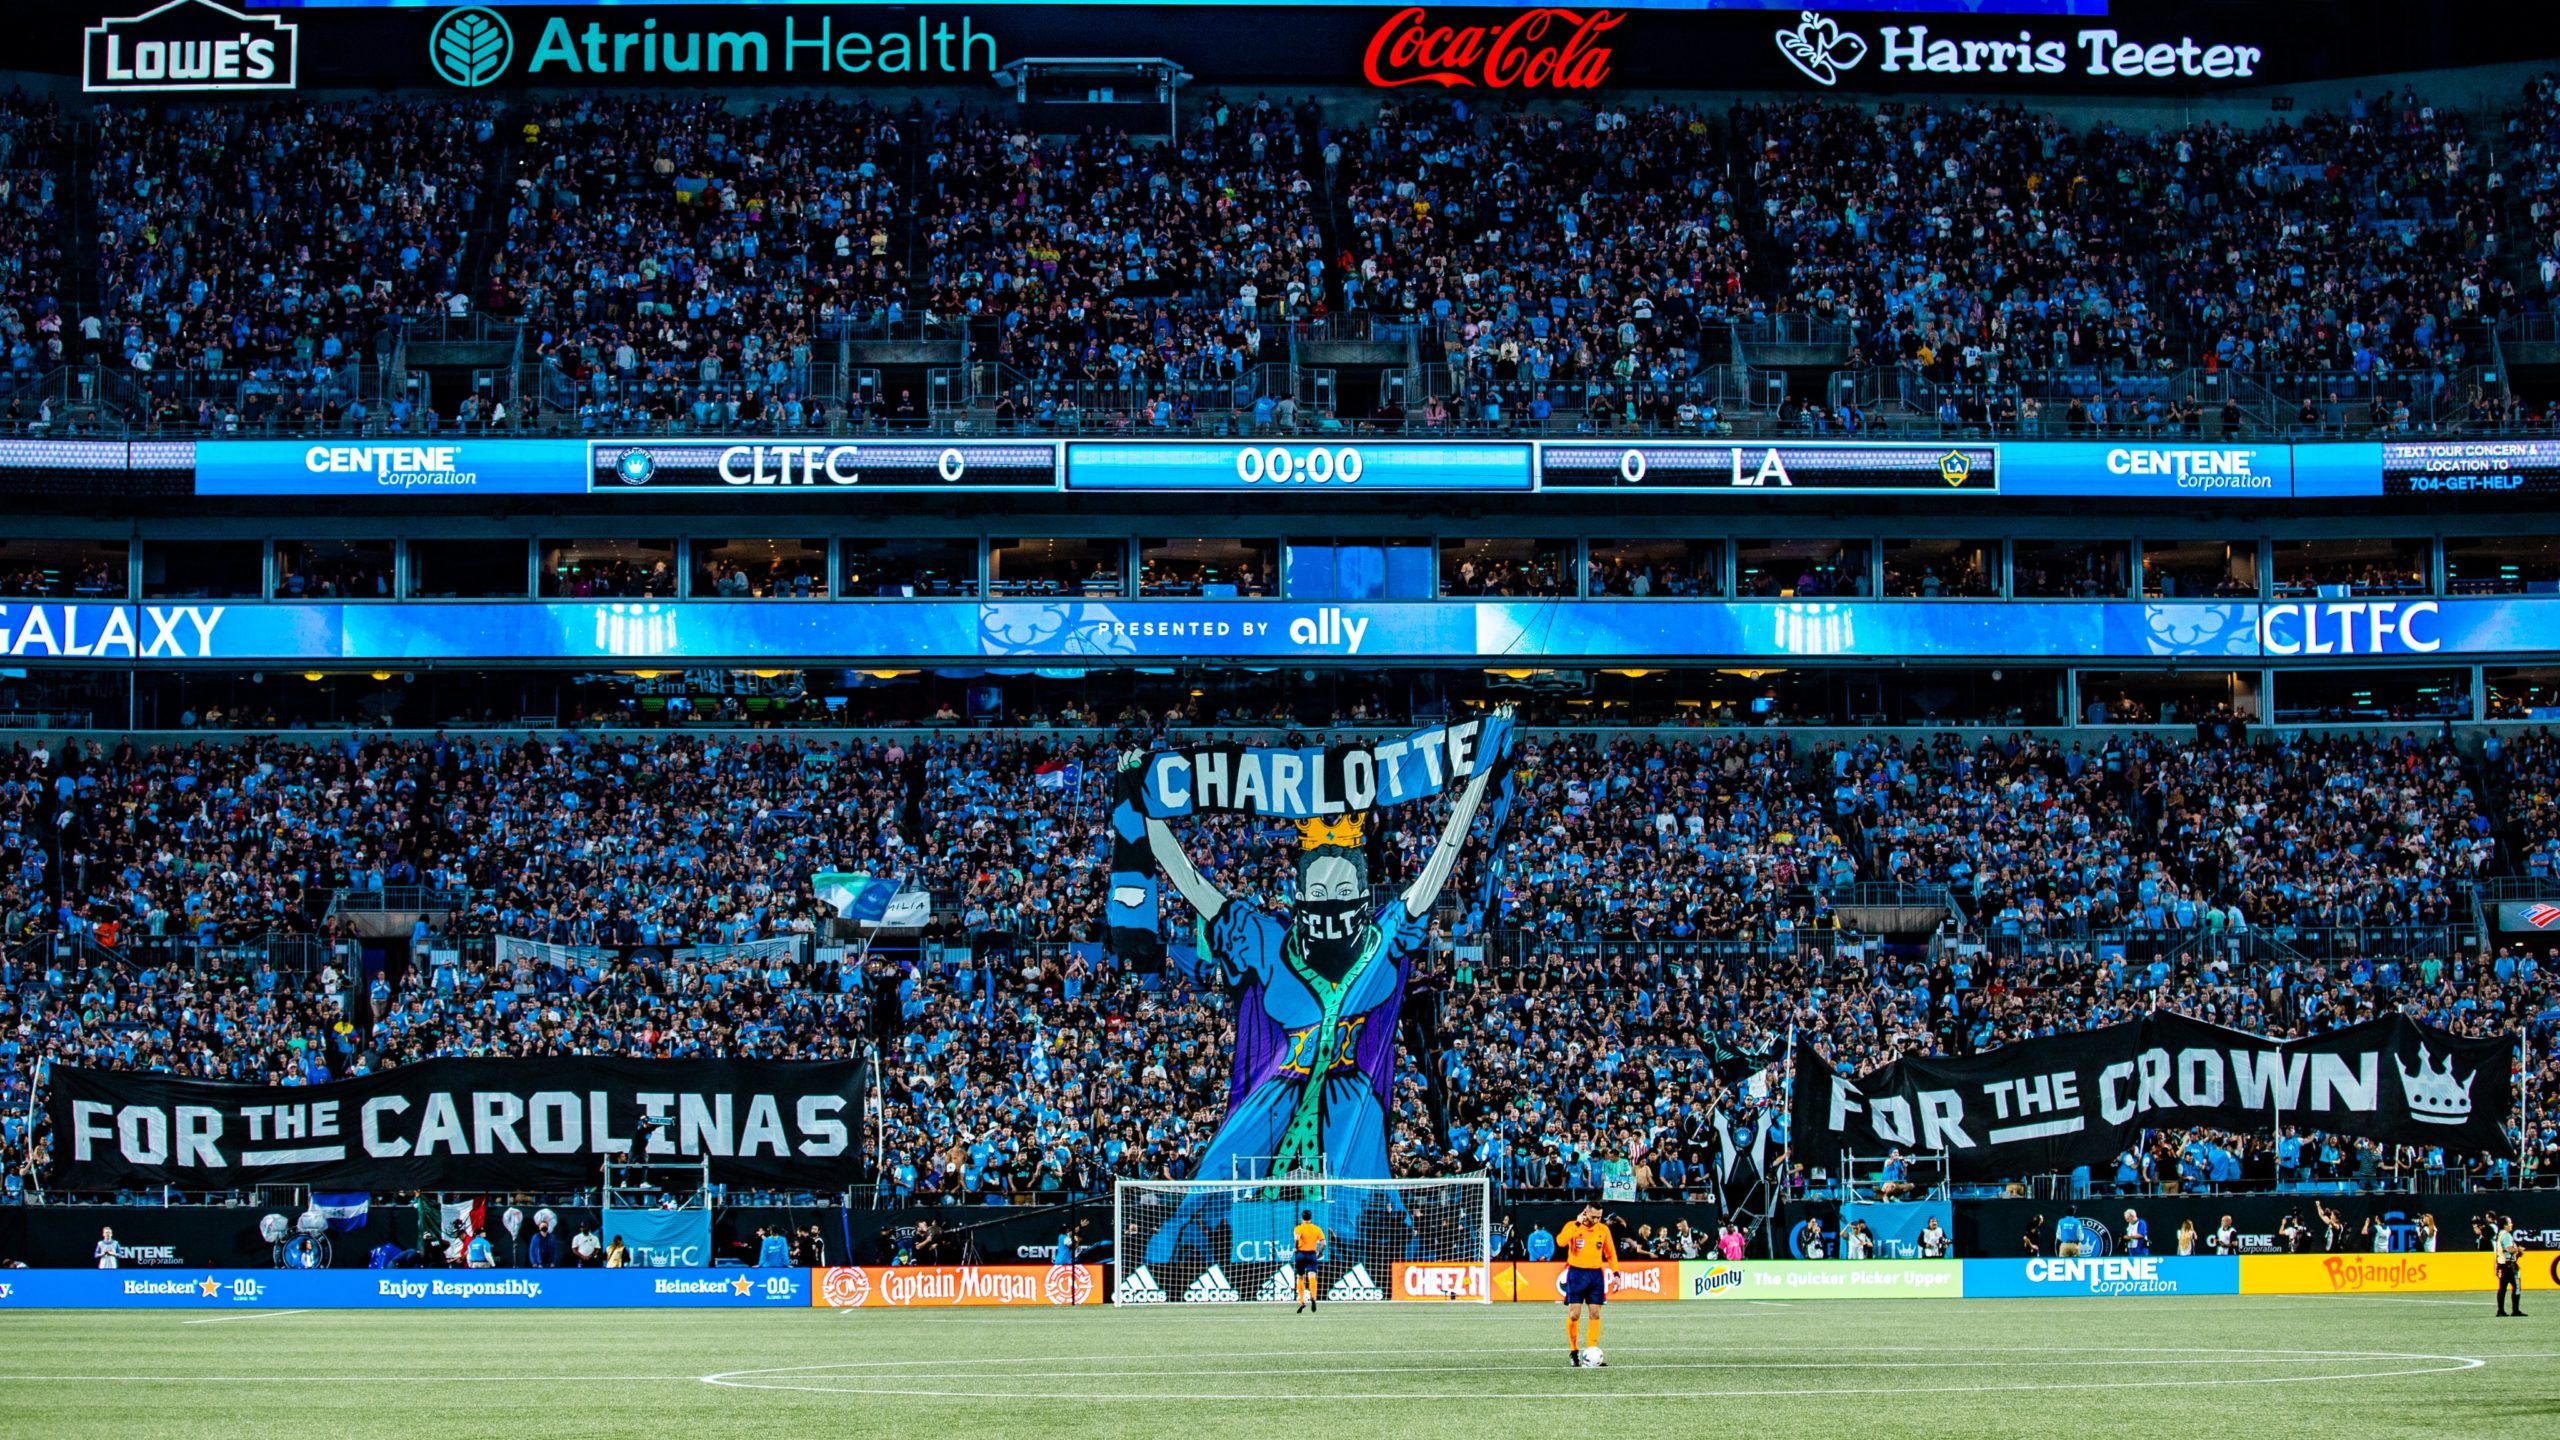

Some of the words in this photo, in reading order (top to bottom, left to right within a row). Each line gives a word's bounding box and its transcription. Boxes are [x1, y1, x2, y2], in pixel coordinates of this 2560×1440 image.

[106, 33, 275, 80] LOWE'S
[528, 17, 768, 72] Atrium
[786, 15, 997, 72] Health
[1363, 7, 1627, 88] Coca-Cola
[1880, 25, 2066, 75] Harris
[2078, 28, 2262, 79] Teeter
[305, 446, 456, 473] CENTENE
[2106, 448, 2252, 476] CENTENE
[2397, 446, 2426, 458] TEXT
[2429, 446, 2463, 457] YOUR
[2465, 445, 2527, 457] CONCERN
[2528, 445, 2538, 455] &
[718, 446, 859, 486] CLTFC
[938, 448, 965, 482] 0
[1236, 447, 1364, 484] 00:00
[1620, 448, 1646, 483] 0
[1731, 448, 1793, 487] LA
[2426, 459, 2489, 471] LOCATION
[2492, 459, 2509, 470] TO
[378, 469, 476, 489] Corporation
[2177, 471, 2272, 492] Corporation
[2409, 476, 2524, 491] 704-GET-HELP
[1098, 621, 1230, 637] PRESENTED
[1243, 621, 1268, 637] BY
[1289, 607, 1369, 654] ally
[2260, 601, 2441, 655] CLTFC
[1156, 720, 1479, 815] CHARLOTTE
[1308, 909, 1356, 940] CLT
[1828, 1073, 1976, 1150] FOR
[1984, 1070, 2083, 1121] THE
[2099, 1047, 2378, 1128] CROWN
[72, 1099, 228, 1168] FOR
[240, 1100, 341, 1141] THE
[360, 1091, 849, 1158] CAROLINAS
[120, 1246, 174, 1259] ENTENE
[2206, 1234, 2273, 1247] CTENE
[2238, 1245, 2282, 1255] Corporation
[628, 1246, 654, 1267] LT
[669, 1246, 699, 1267] FC
[1695, 1270, 1742, 1296] Bounty
[1754, 1272, 1783, 1286] The
[1787, 1271, 1846, 1287] Quicker
[1851, 1271, 1899, 1286] Picker
[1904, 1270, 1951, 1288] Upper
[2025, 1258, 2159, 1284] CENTENE
[2323, 1256, 2427, 1291] Bojangles
[123, 1279, 195, 1294] Heineken
[379, 1280, 429, 1299] Enjoy
[433, 1279, 542, 1299] Responsibly.
[655, 1279, 727, 1293] Heineken
[880, 1268, 955, 1305] Captain
[954, 1266, 1037, 1304] Morgan
[1184, 1287, 1239, 1303] adidas
[1328, 1287, 1383, 1301] adidas
[2090, 1278, 2177, 1297] Corporation
